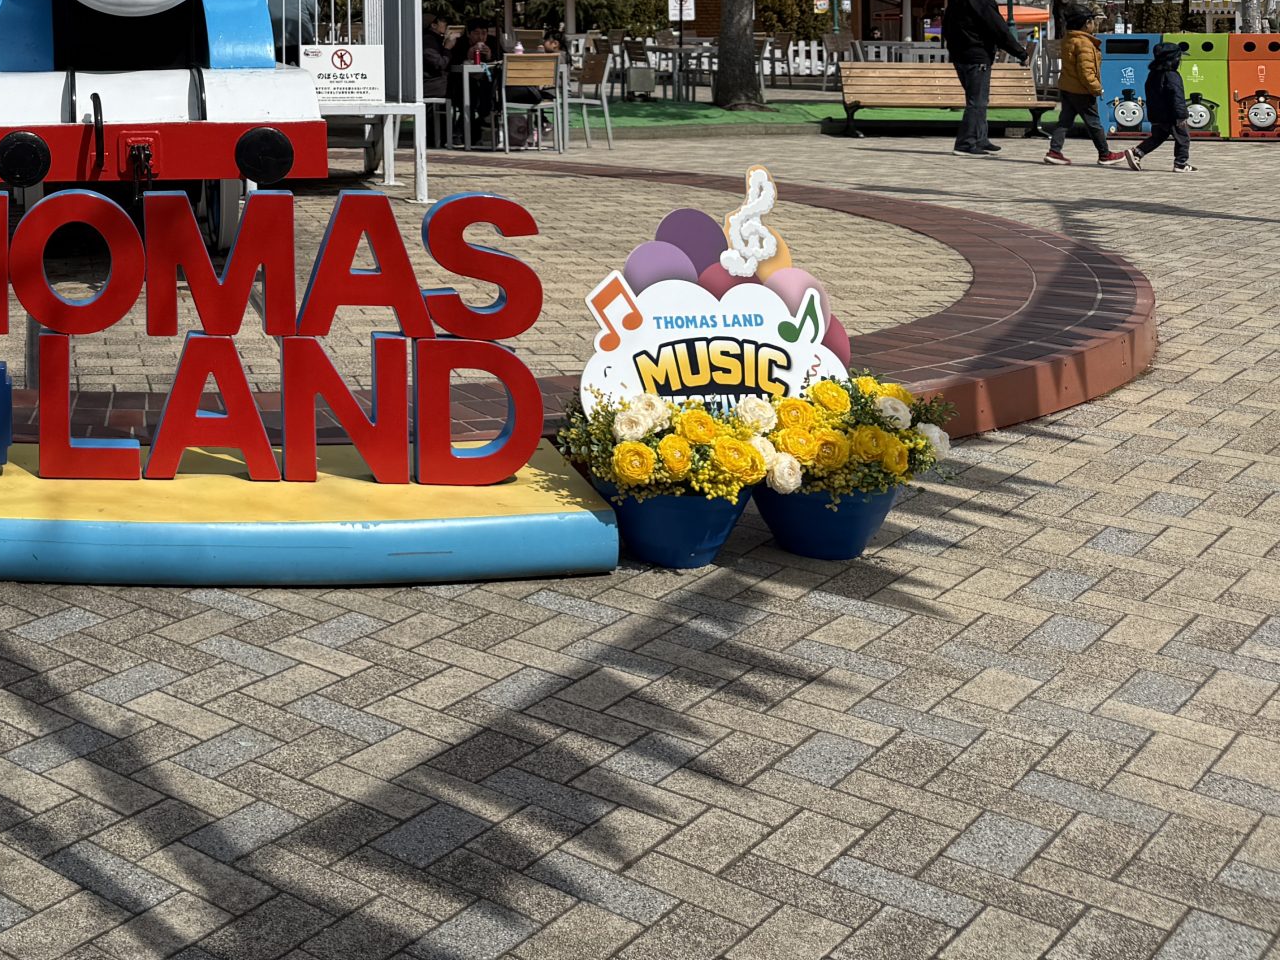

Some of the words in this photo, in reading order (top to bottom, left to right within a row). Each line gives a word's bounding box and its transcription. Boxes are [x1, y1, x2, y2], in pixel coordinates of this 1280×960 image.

[653, 315, 718, 329] THOMAS
[722, 313, 764, 328] LAND
[634, 338, 790, 397] MUSIC
[38, 331, 544, 485] LAND
